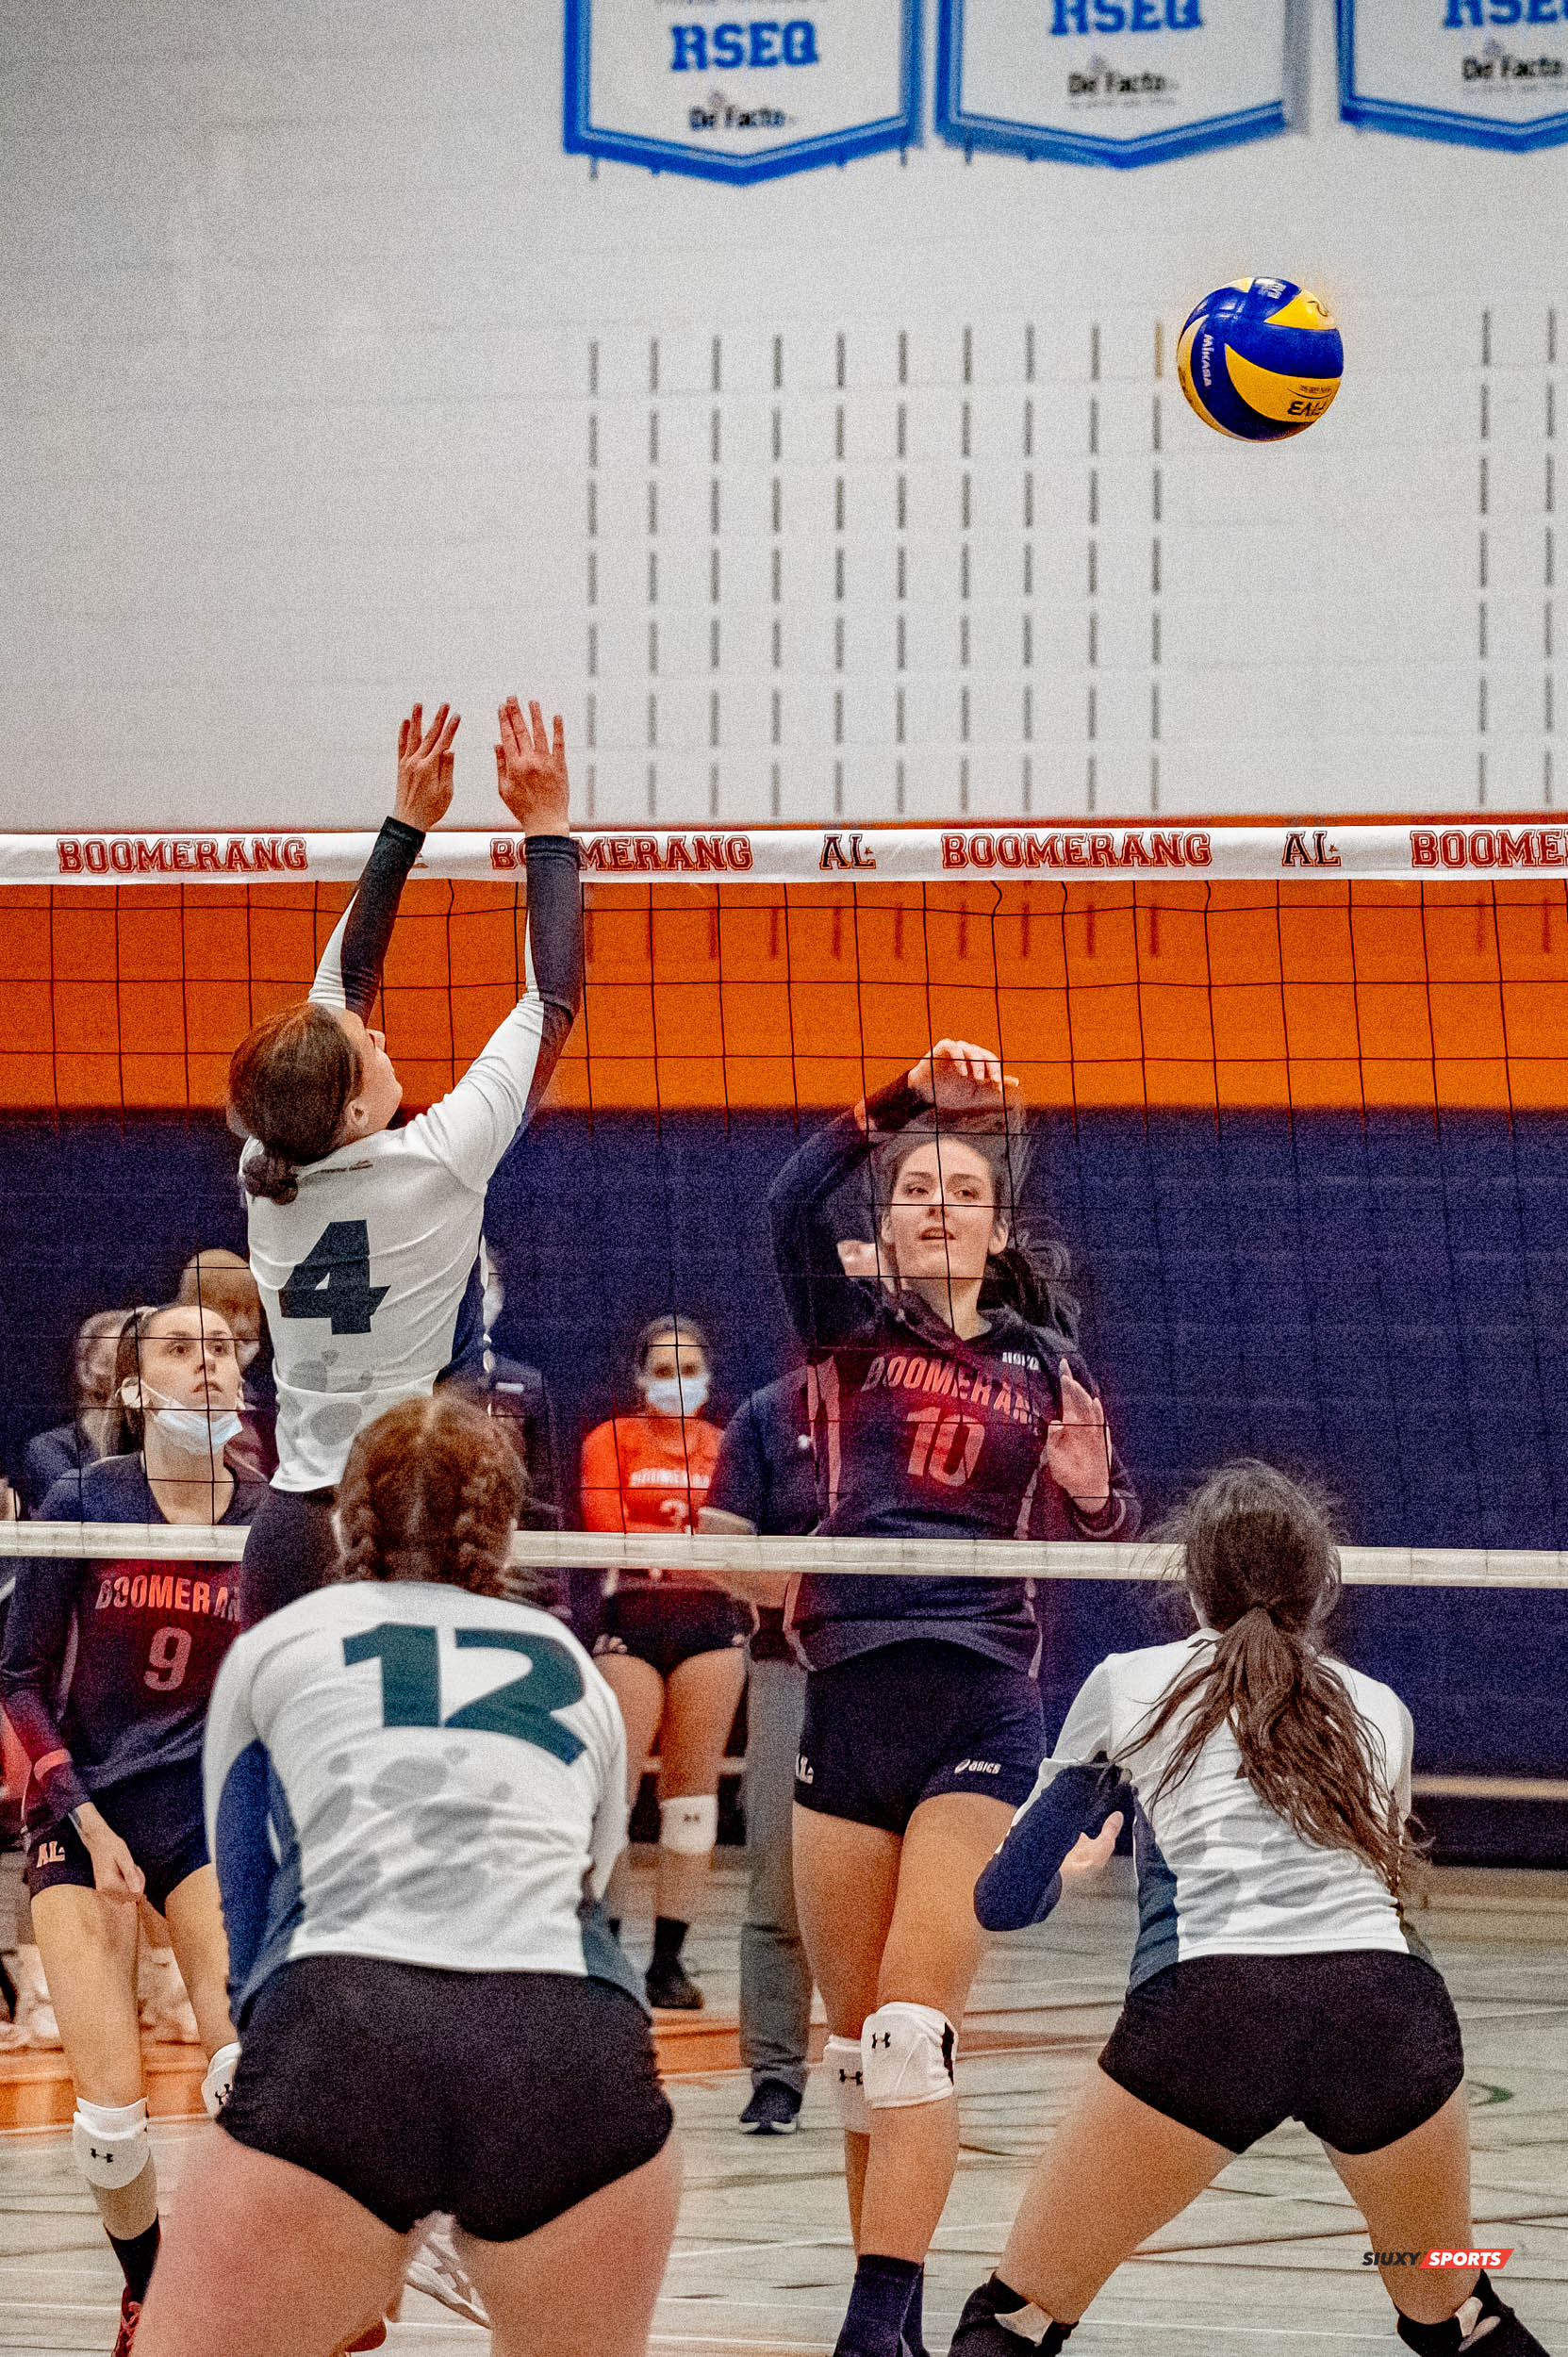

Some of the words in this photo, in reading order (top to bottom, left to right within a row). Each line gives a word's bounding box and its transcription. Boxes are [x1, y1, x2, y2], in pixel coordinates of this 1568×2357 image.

[1051, 0, 1204, 35] RSEQ
[1444, 0, 1568, 28] RSE
[671, 21, 818, 71] RSEQ
[57, 836, 308, 873] BOOMERANG
[490, 835, 753, 871] BMERANG
[819, 833, 876, 870] AL
[941, 831, 1213, 868] BOOMERANG
[1281, 831, 1342, 867] AL
[1411, 829, 1568, 868] BOOME
[279, 1219, 391, 1335] 4
[861, 1355, 1038, 1426] BOOMERAN
[907, 1406, 985, 1487] 10
[95, 1574, 240, 1622] BOOMERAN
[143, 1626, 192, 1691] 9
[342, 1621, 587, 1766] 12
[36, 1840, 66, 1868] AL
